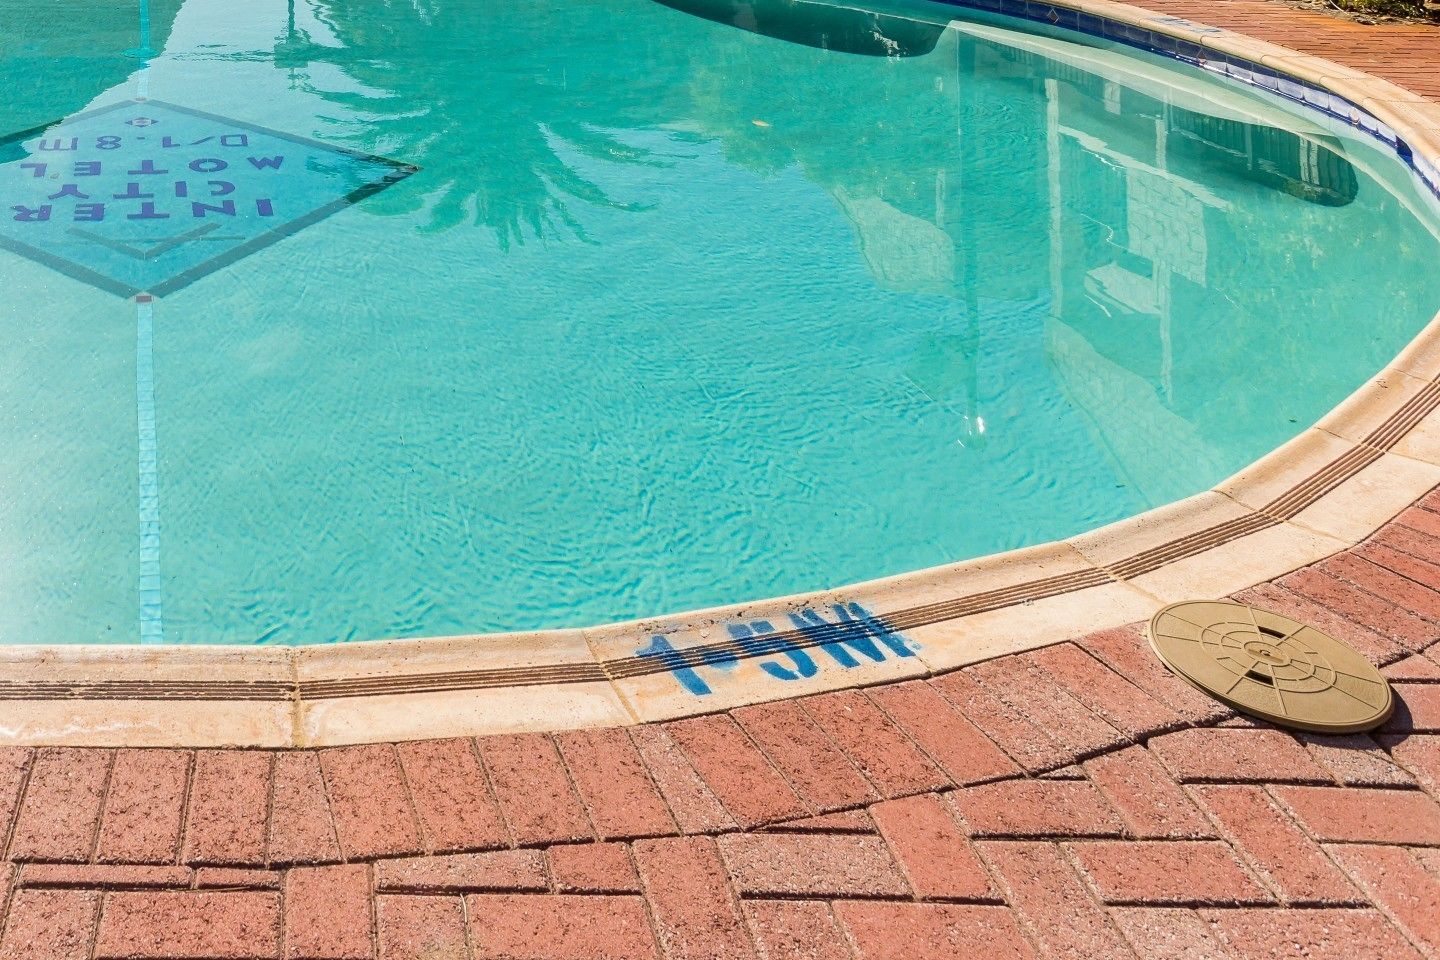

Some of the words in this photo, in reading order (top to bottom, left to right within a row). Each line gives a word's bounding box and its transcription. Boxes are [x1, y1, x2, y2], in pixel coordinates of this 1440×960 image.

[20, 155, 284, 178] MOTEL
[47, 180, 236, 200] CITY
[11, 198, 274, 222] INTER
